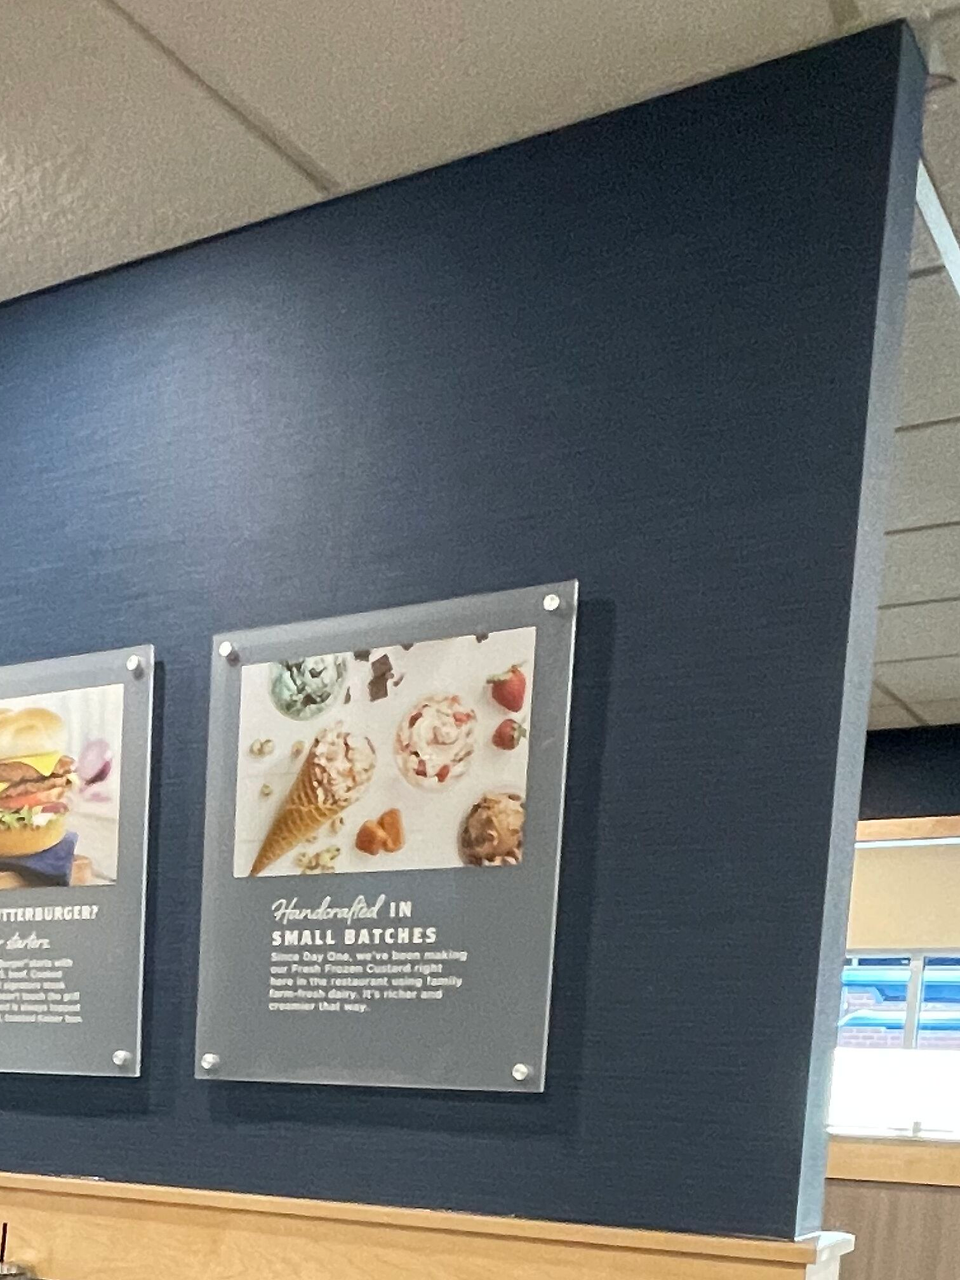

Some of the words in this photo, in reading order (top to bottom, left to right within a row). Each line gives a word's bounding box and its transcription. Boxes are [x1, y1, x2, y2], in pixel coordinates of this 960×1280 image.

[271, 894, 386, 924] Handcrafted
[389, 900, 412, 918] IN
[271, 929, 336, 945] SMALL
[343, 927, 437, 945] BATCHES
[270, 951, 300, 962] Since
[302, 951, 324, 963] Day
[355, 950, 389, 960] we've
[391, 950, 421, 960] been
[423, 950, 468, 961] making
[291, 964, 322, 974] Fresh
[324, 963, 364, 974] Frozen
[365, 963, 412, 974] Custard
[414, 963, 443, 975] right
[296, 976, 308, 986] in
[330, 976, 389, 986] restaurant
[426, 975, 463, 988] family
[420, 989, 443, 999] and
